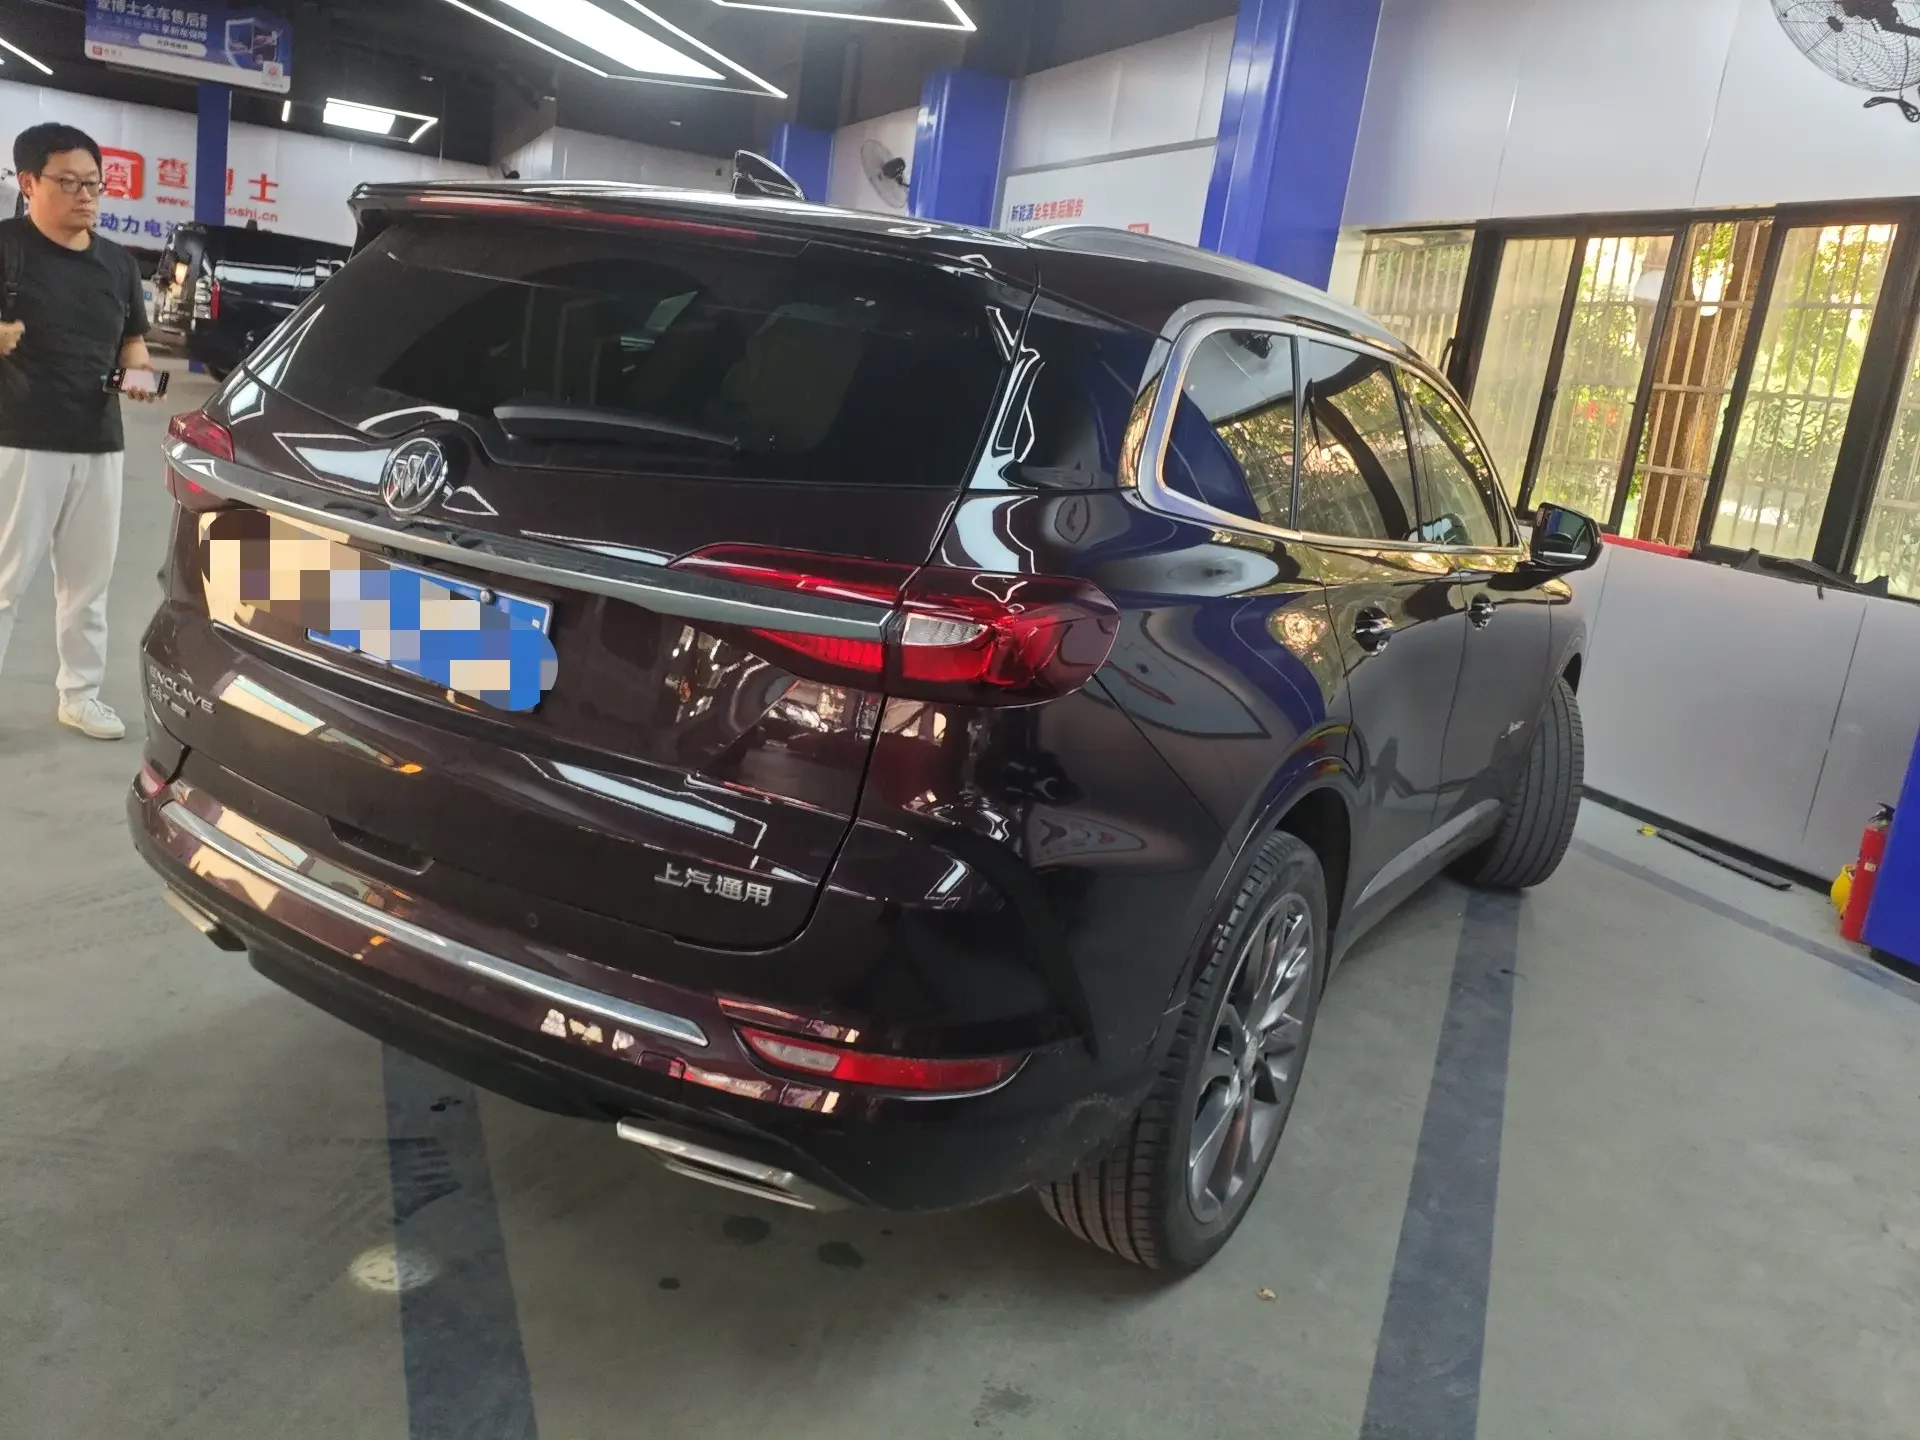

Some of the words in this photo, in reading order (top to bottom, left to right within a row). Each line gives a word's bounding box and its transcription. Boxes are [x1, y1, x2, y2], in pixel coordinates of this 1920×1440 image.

[149, 664, 216, 714] ENCLAVE
[653, 861, 773, 907] 上汽通用
